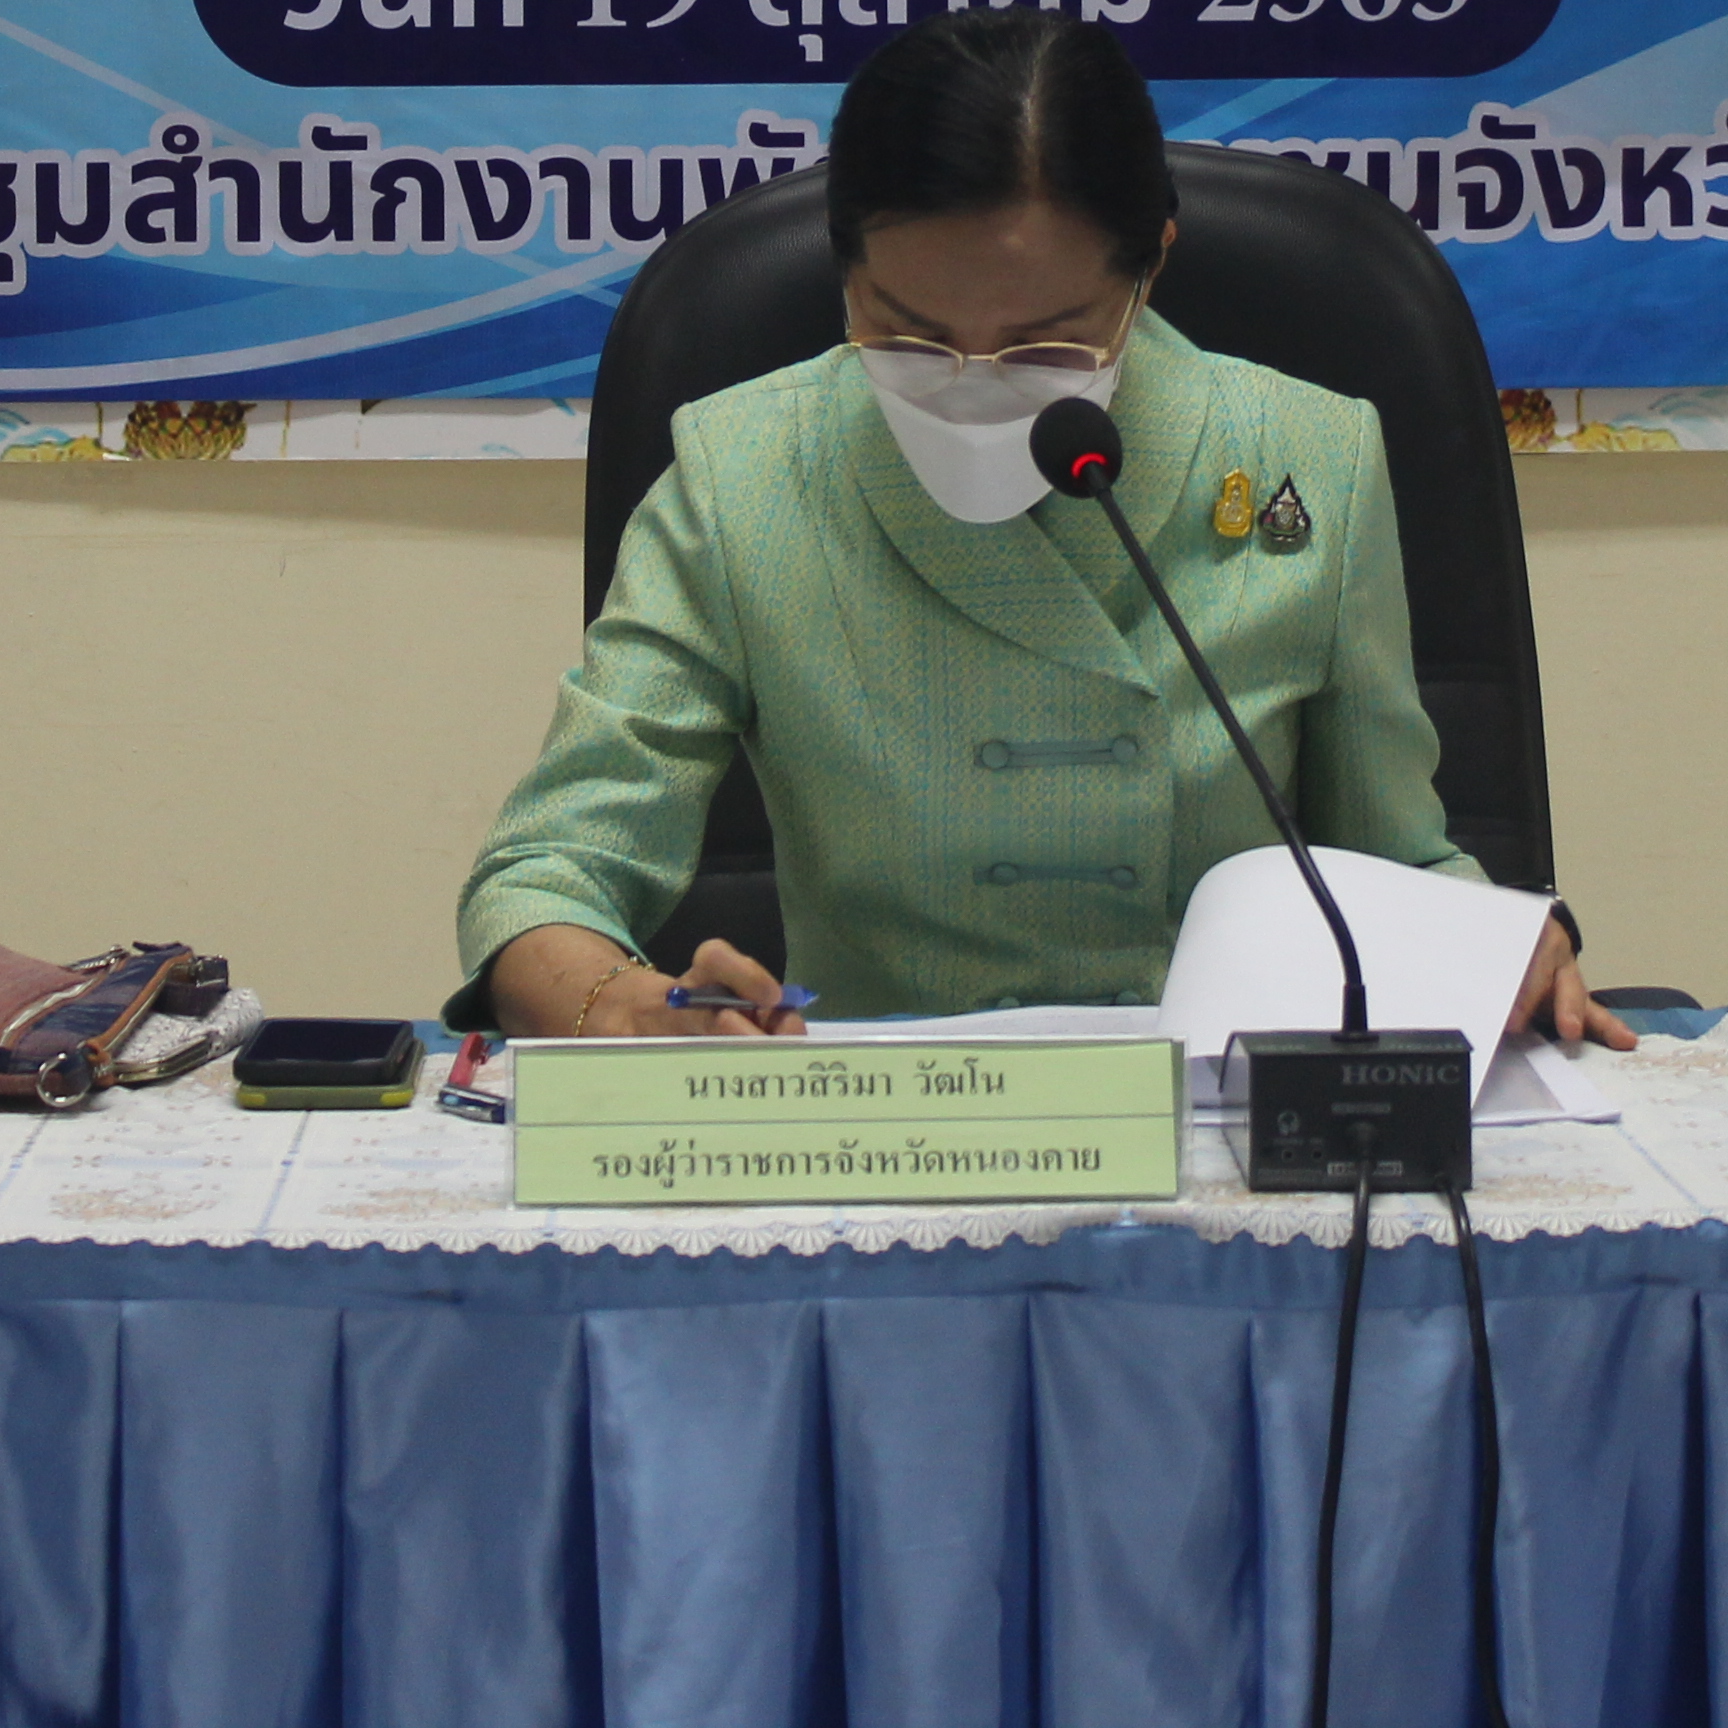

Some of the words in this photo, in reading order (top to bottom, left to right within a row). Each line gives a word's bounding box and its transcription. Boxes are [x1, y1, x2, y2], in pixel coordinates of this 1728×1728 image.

[684, 1060, 894, 1100] นางสาวสิริมา
[592, 1138, 1104, 1190] รองผู้ว่าราชการจังหวัดหนองคาย
